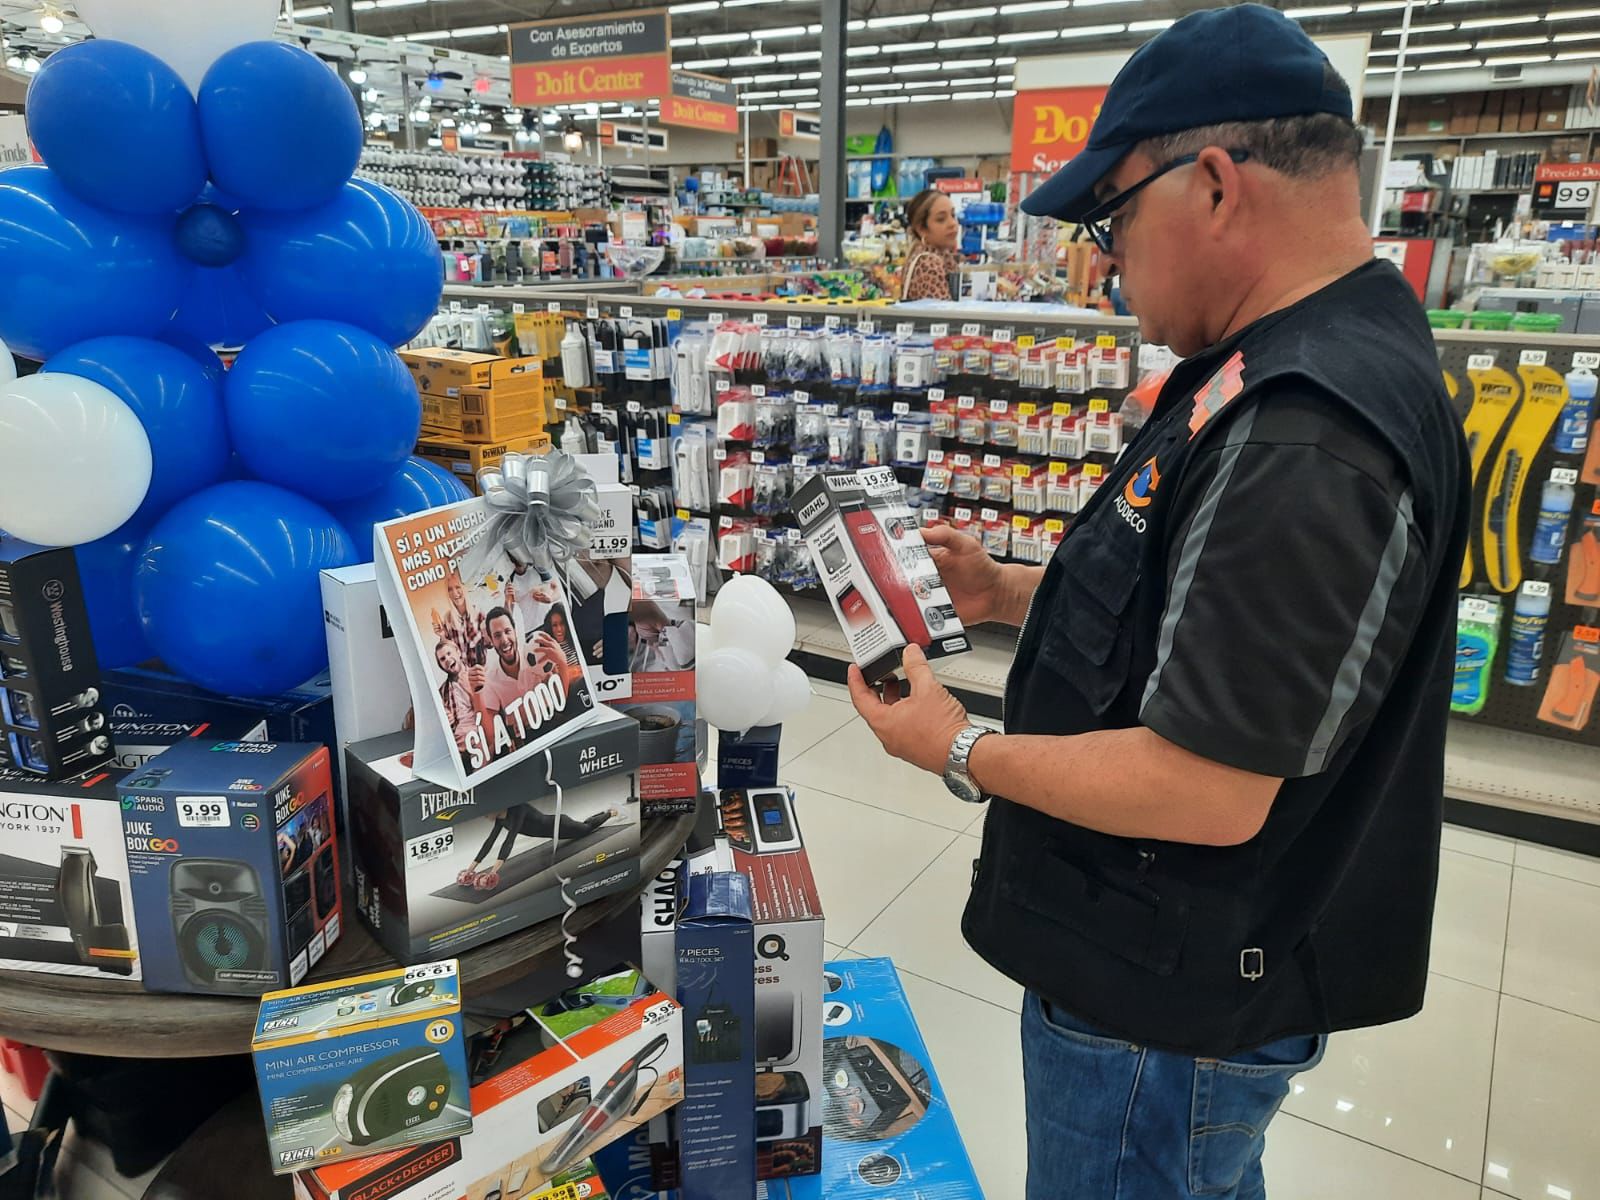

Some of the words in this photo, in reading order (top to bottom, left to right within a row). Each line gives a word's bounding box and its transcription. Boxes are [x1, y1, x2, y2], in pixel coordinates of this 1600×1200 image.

[530, 30, 553, 43] Con
[556, 21, 645, 40] Asesoramiento
[552, 44, 567, 57] de
[569, 40, 623, 56] Expertos
[578, 66, 644, 93] Center
[830, 476, 861, 488] WAHL
[864, 472, 896, 486] 19.99
[801, 496, 825, 519] WAHL
[396, 531, 411, 554] SÍ
[413, 533, 423, 548] A
[425, 524, 446, 543] UN
[448, 511, 486, 534] HOGAR
[590, 538, 628, 549] 11.99
[402, 549, 432, 573] MÁS
[407, 564, 446, 591] COMO
[50, 600, 73, 672] Westinghouse
[465, 712, 491, 769] SÍ
[493, 714, 512, 755] A
[505, 673, 567, 740] TODO
[579, 746, 597, 761] AB
[580, 753, 624, 774] WHEEL
[135, 795, 163, 804] SPARQ
[274, 785, 291, 808] JUKE
[420, 789, 477, 821] EVERLAST
[136, 804, 165, 812] AUDIO
[183, 804, 221, 816] 9.99
[36, 825, 61, 834] 1937
[126, 821, 153, 835] JUKE
[411, 834, 454, 857] 18.99
[575, 870, 630, 896] POWERCORE
[687, 948, 720, 956] PIECES
[405, 967, 452, 980] 19.99
[301, 987, 355, 1001] COMPRESSOR
[643, 1003, 676, 1023] 39.99
[432, 1024, 448, 1037] 10
[265, 1060, 293, 1071] MINI
[297, 1053, 316, 1064] AIR
[319, 1038, 400, 1060] COMPRESSOR
[266, 1072, 285, 1081] MINI
[287, 1063, 334, 1078] COMPRESOR
[336, 1060, 346, 1069] DE
[348, 1057, 363, 1065] AIRE
